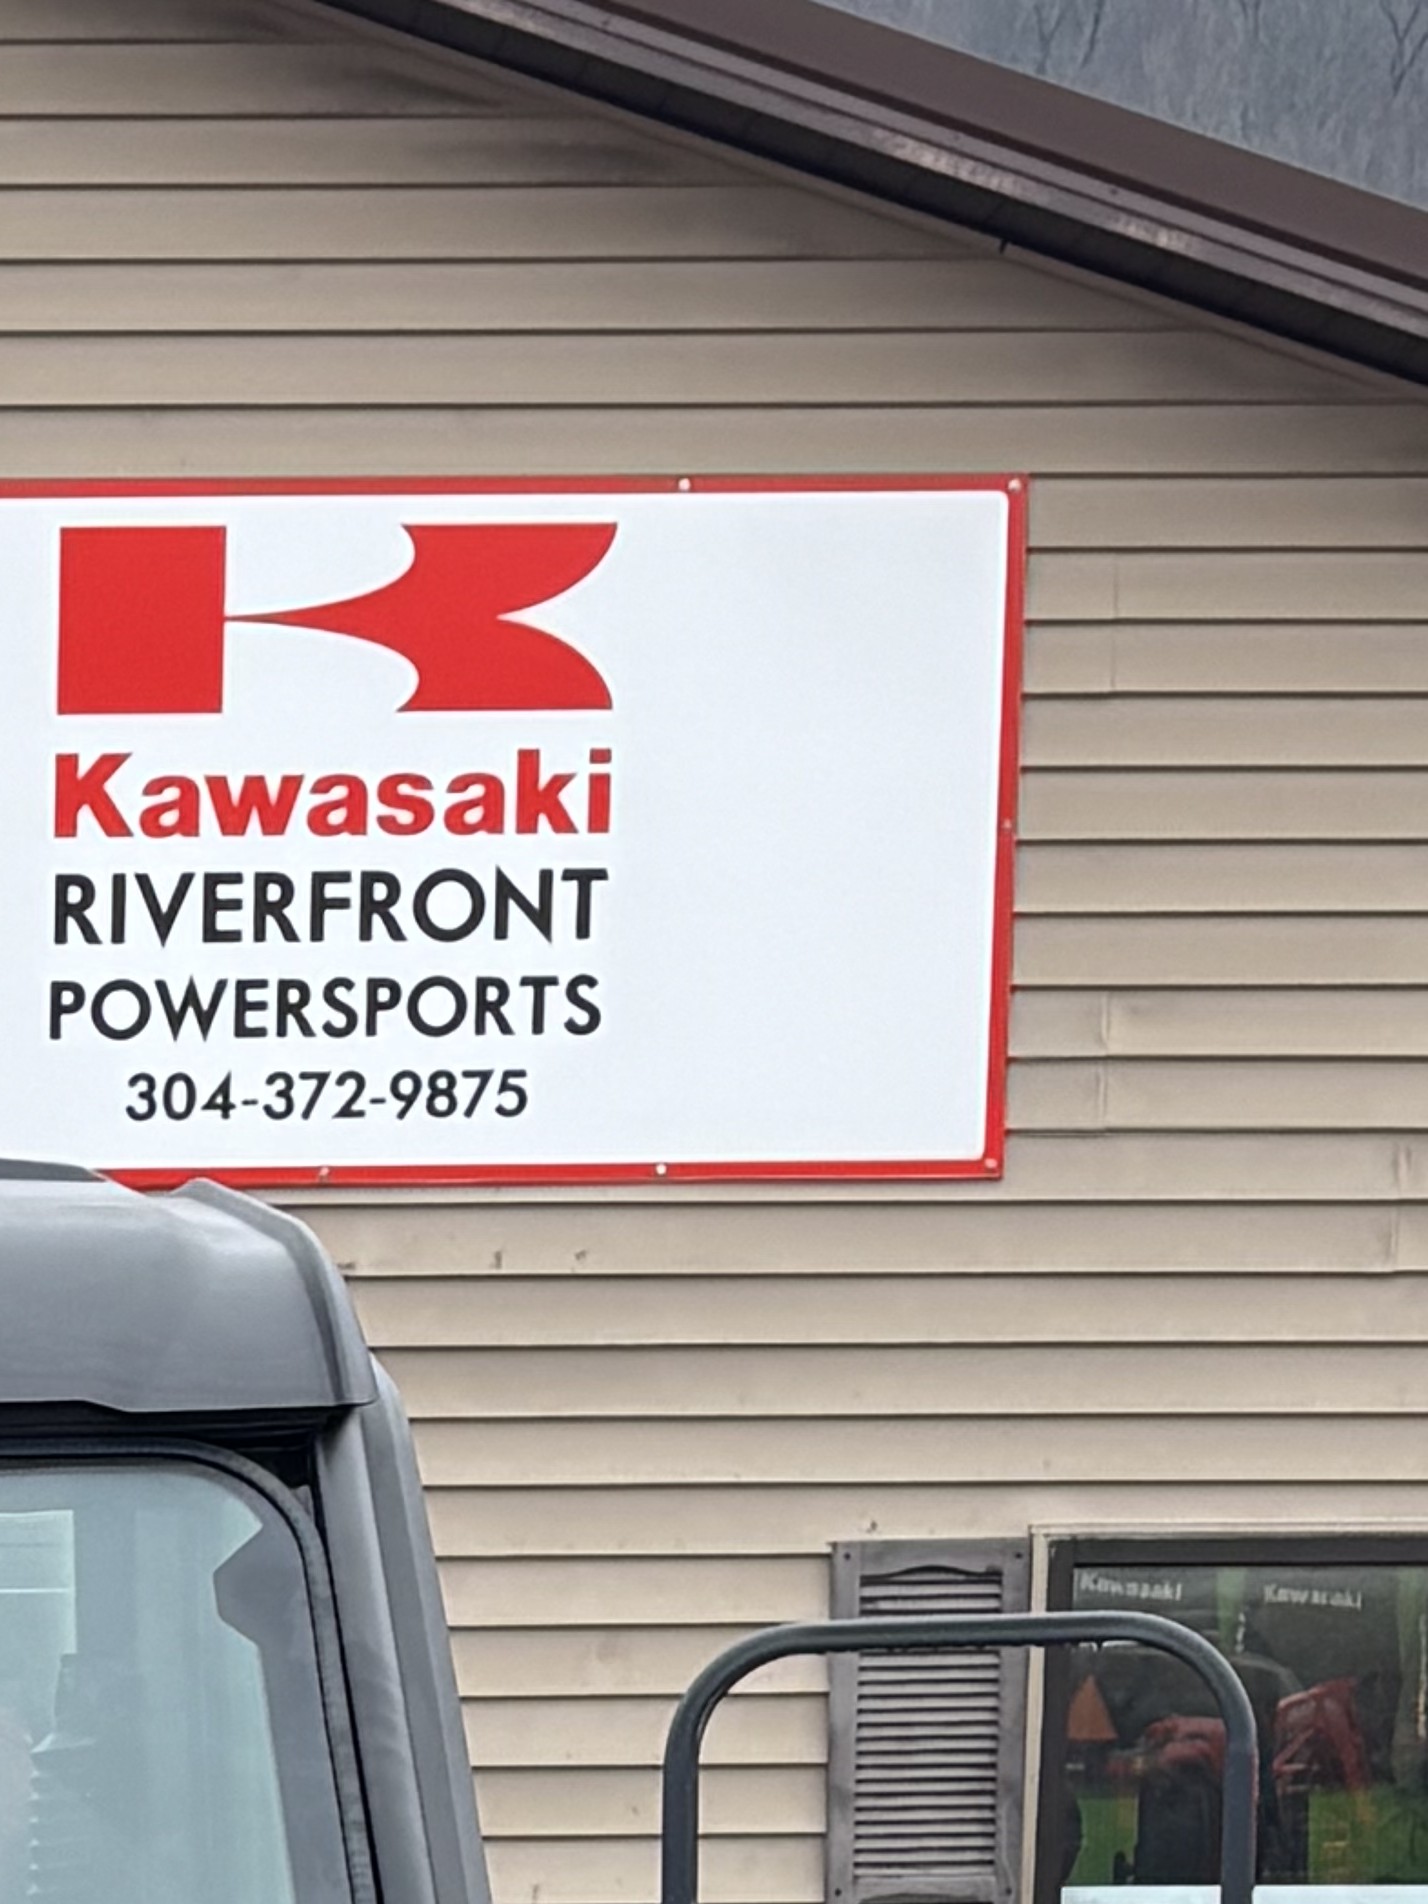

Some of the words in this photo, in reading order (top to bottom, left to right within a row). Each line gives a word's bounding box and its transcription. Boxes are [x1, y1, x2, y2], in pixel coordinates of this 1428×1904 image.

[53, 749, 613, 838] Kawasaki
[54, 865, 608, 947] RIVERFRONT
[48, 974, 602, 1042] POWERSPORTS
[125, 1069, 529, 1121] 304-372-9875
